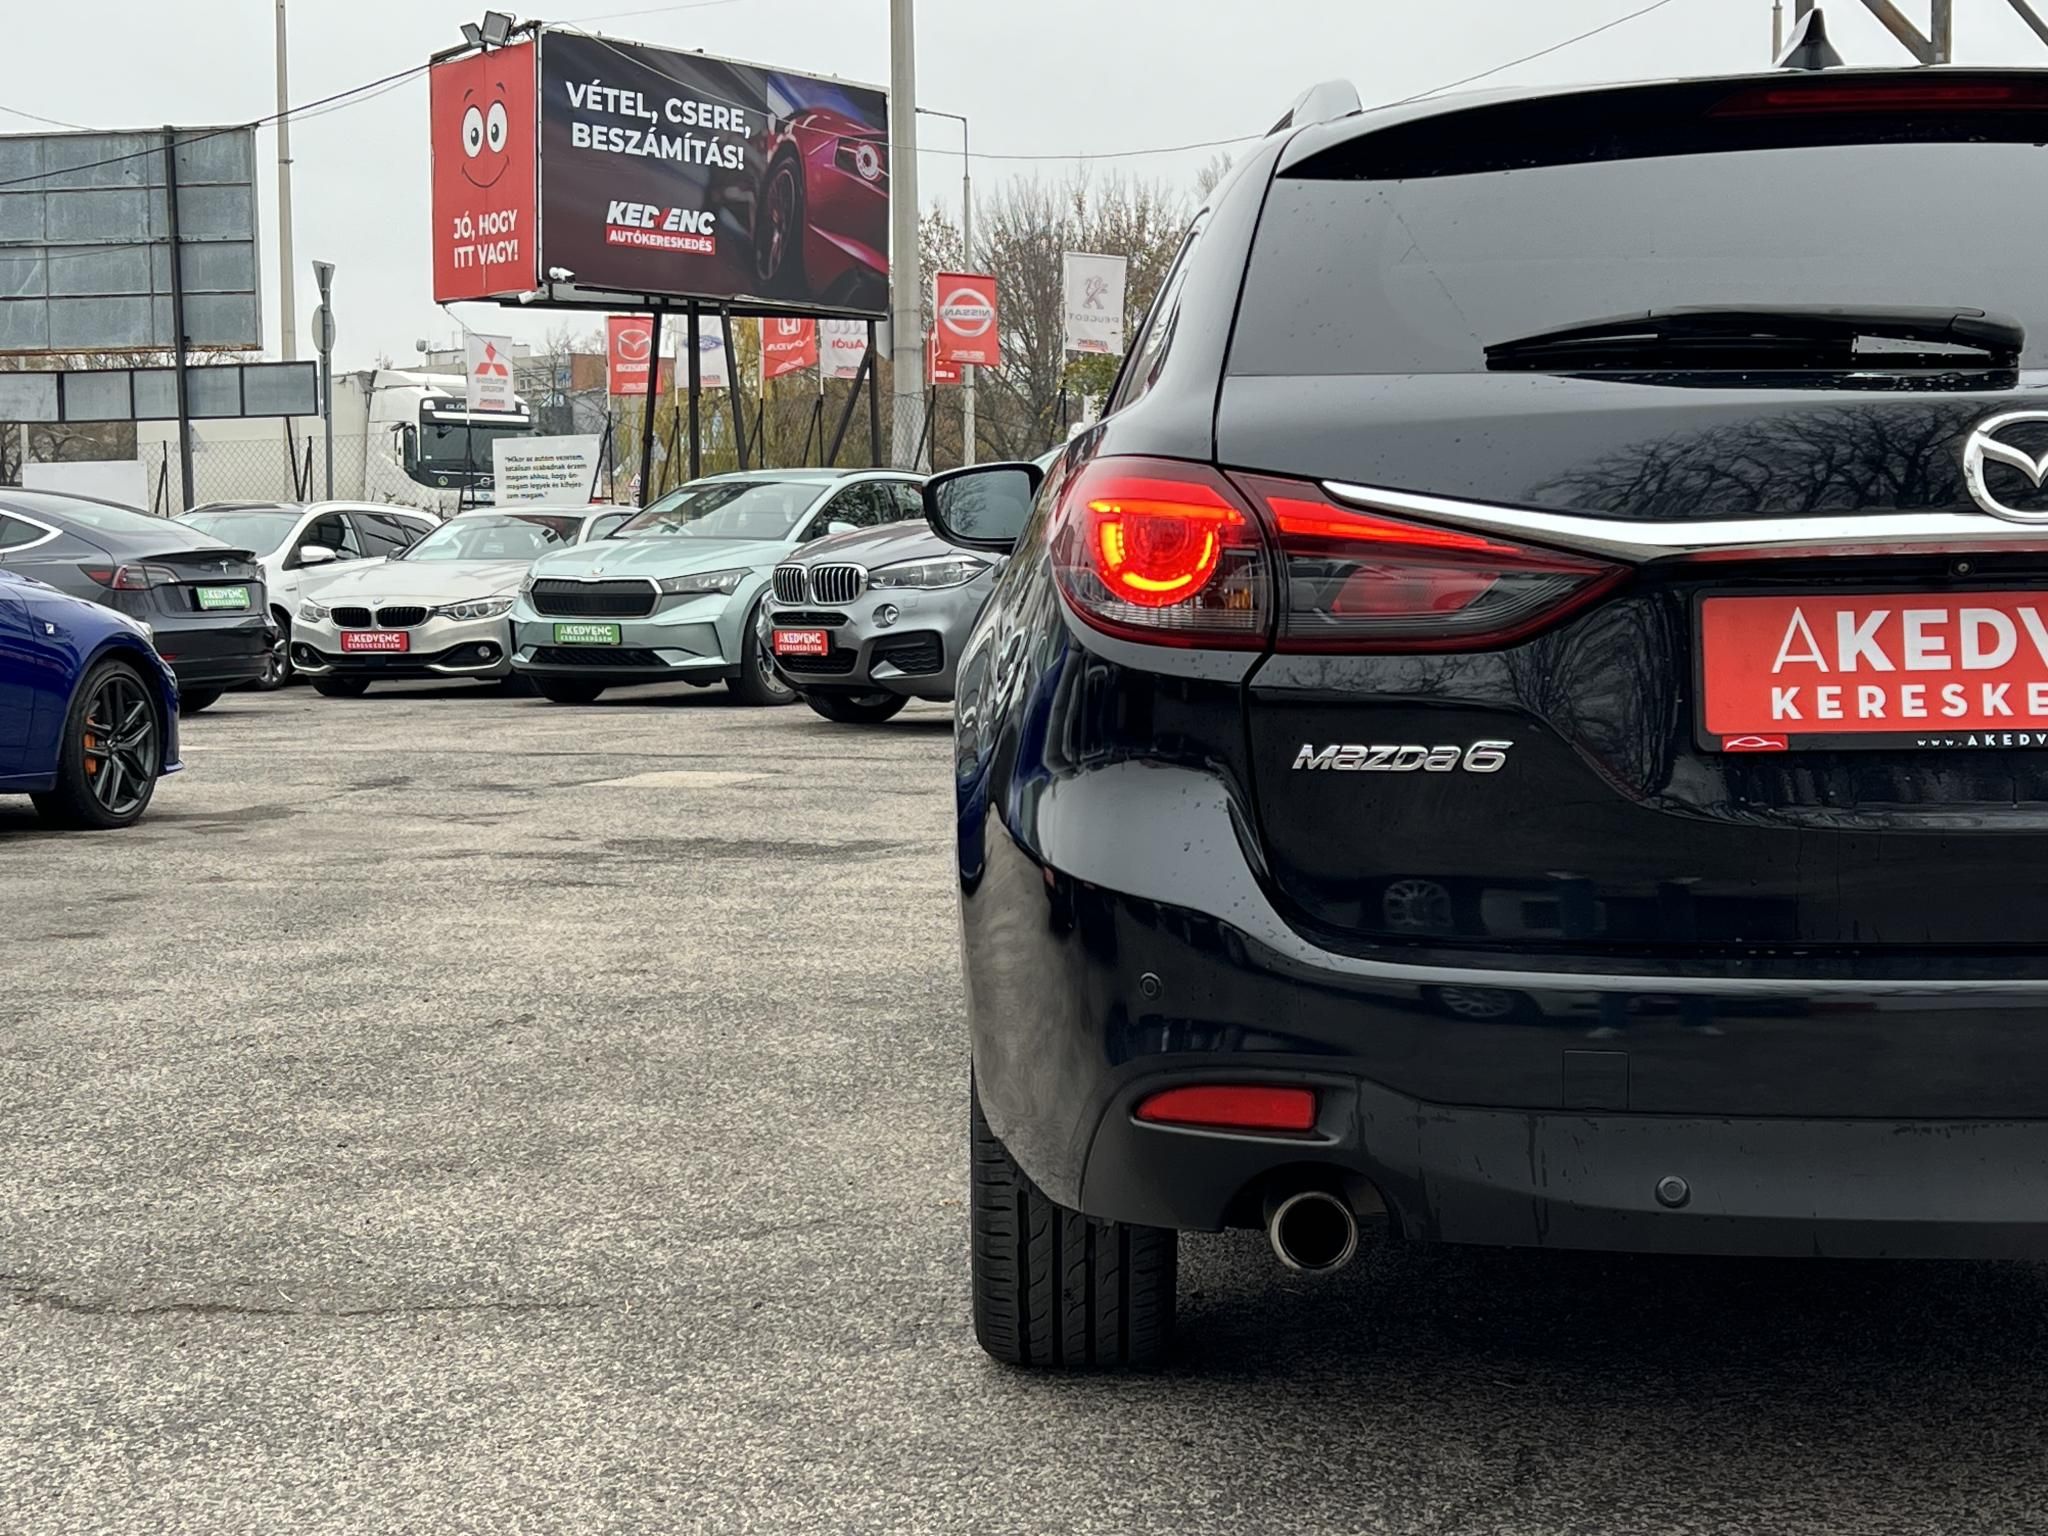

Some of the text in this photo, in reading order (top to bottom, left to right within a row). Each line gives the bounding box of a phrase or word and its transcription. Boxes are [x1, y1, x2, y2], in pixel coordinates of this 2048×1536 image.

[565, 79, 751, 139] VÉTEL, CSERE,
[572, 121, 744, 170] BESZÁMÍTÁS!
[453, 209, 518, 241] JÓ, HOGY
[609, 230, 713, 252] AUTÓKERESKEDÉS
[454, 239, 519, 268] ITT VAGY!
[1771, 682, 2048, 720] KERESKE
